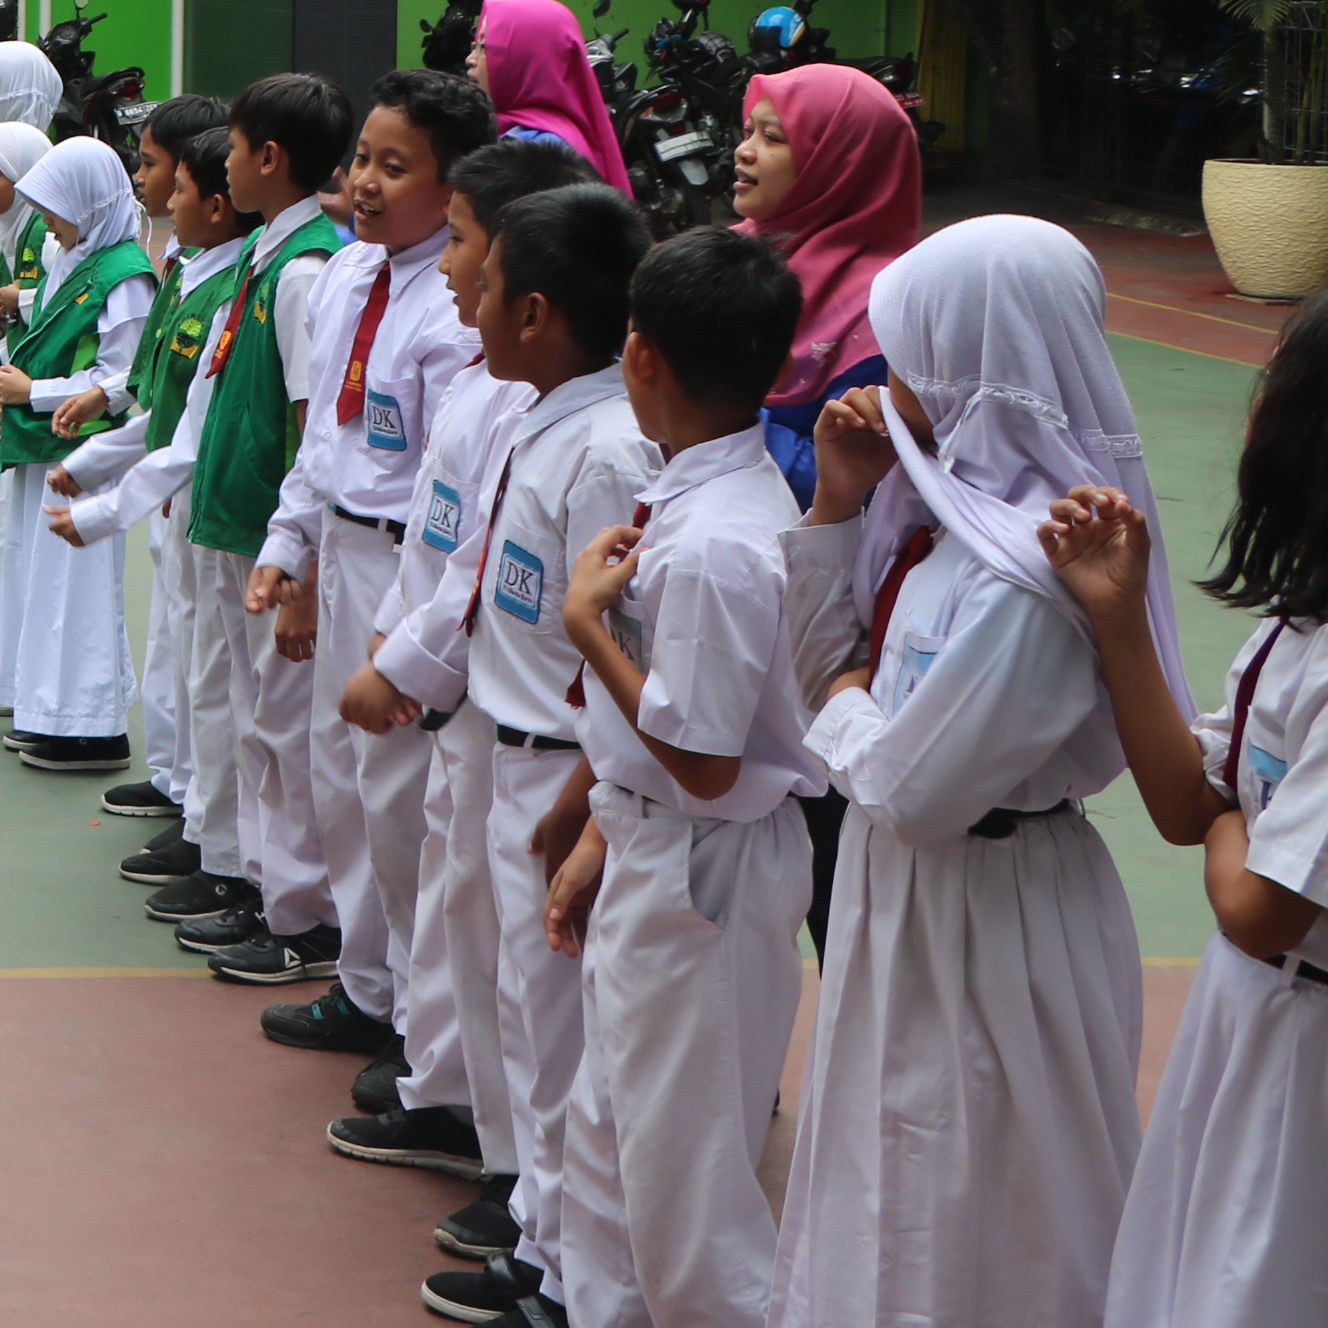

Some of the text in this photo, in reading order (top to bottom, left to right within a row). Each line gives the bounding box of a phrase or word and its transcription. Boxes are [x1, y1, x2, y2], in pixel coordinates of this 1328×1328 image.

[372, 405, 397, 429] DK
[430, 498, 455, 528] DK
[504, 560, 534, 596] DK
